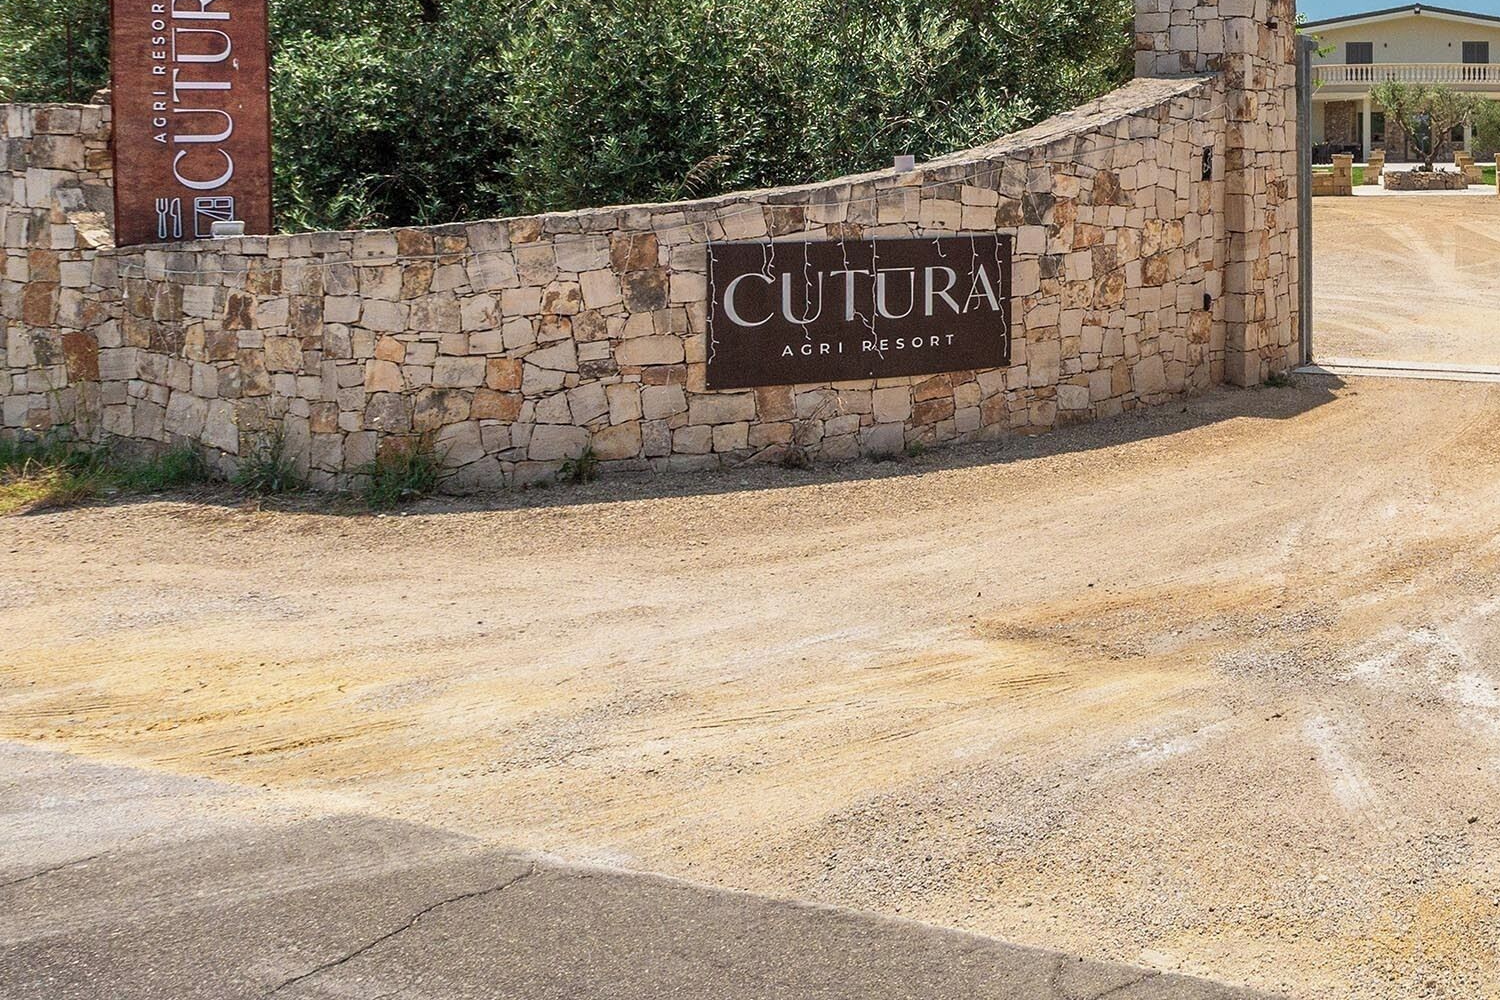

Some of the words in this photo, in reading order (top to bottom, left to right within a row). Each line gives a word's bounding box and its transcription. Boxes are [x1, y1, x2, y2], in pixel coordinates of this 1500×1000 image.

[152, 90, 168, 144] AGRI
[781, 342, 844, 358] AGRI
[861, 333, 956, 353] RESORT
